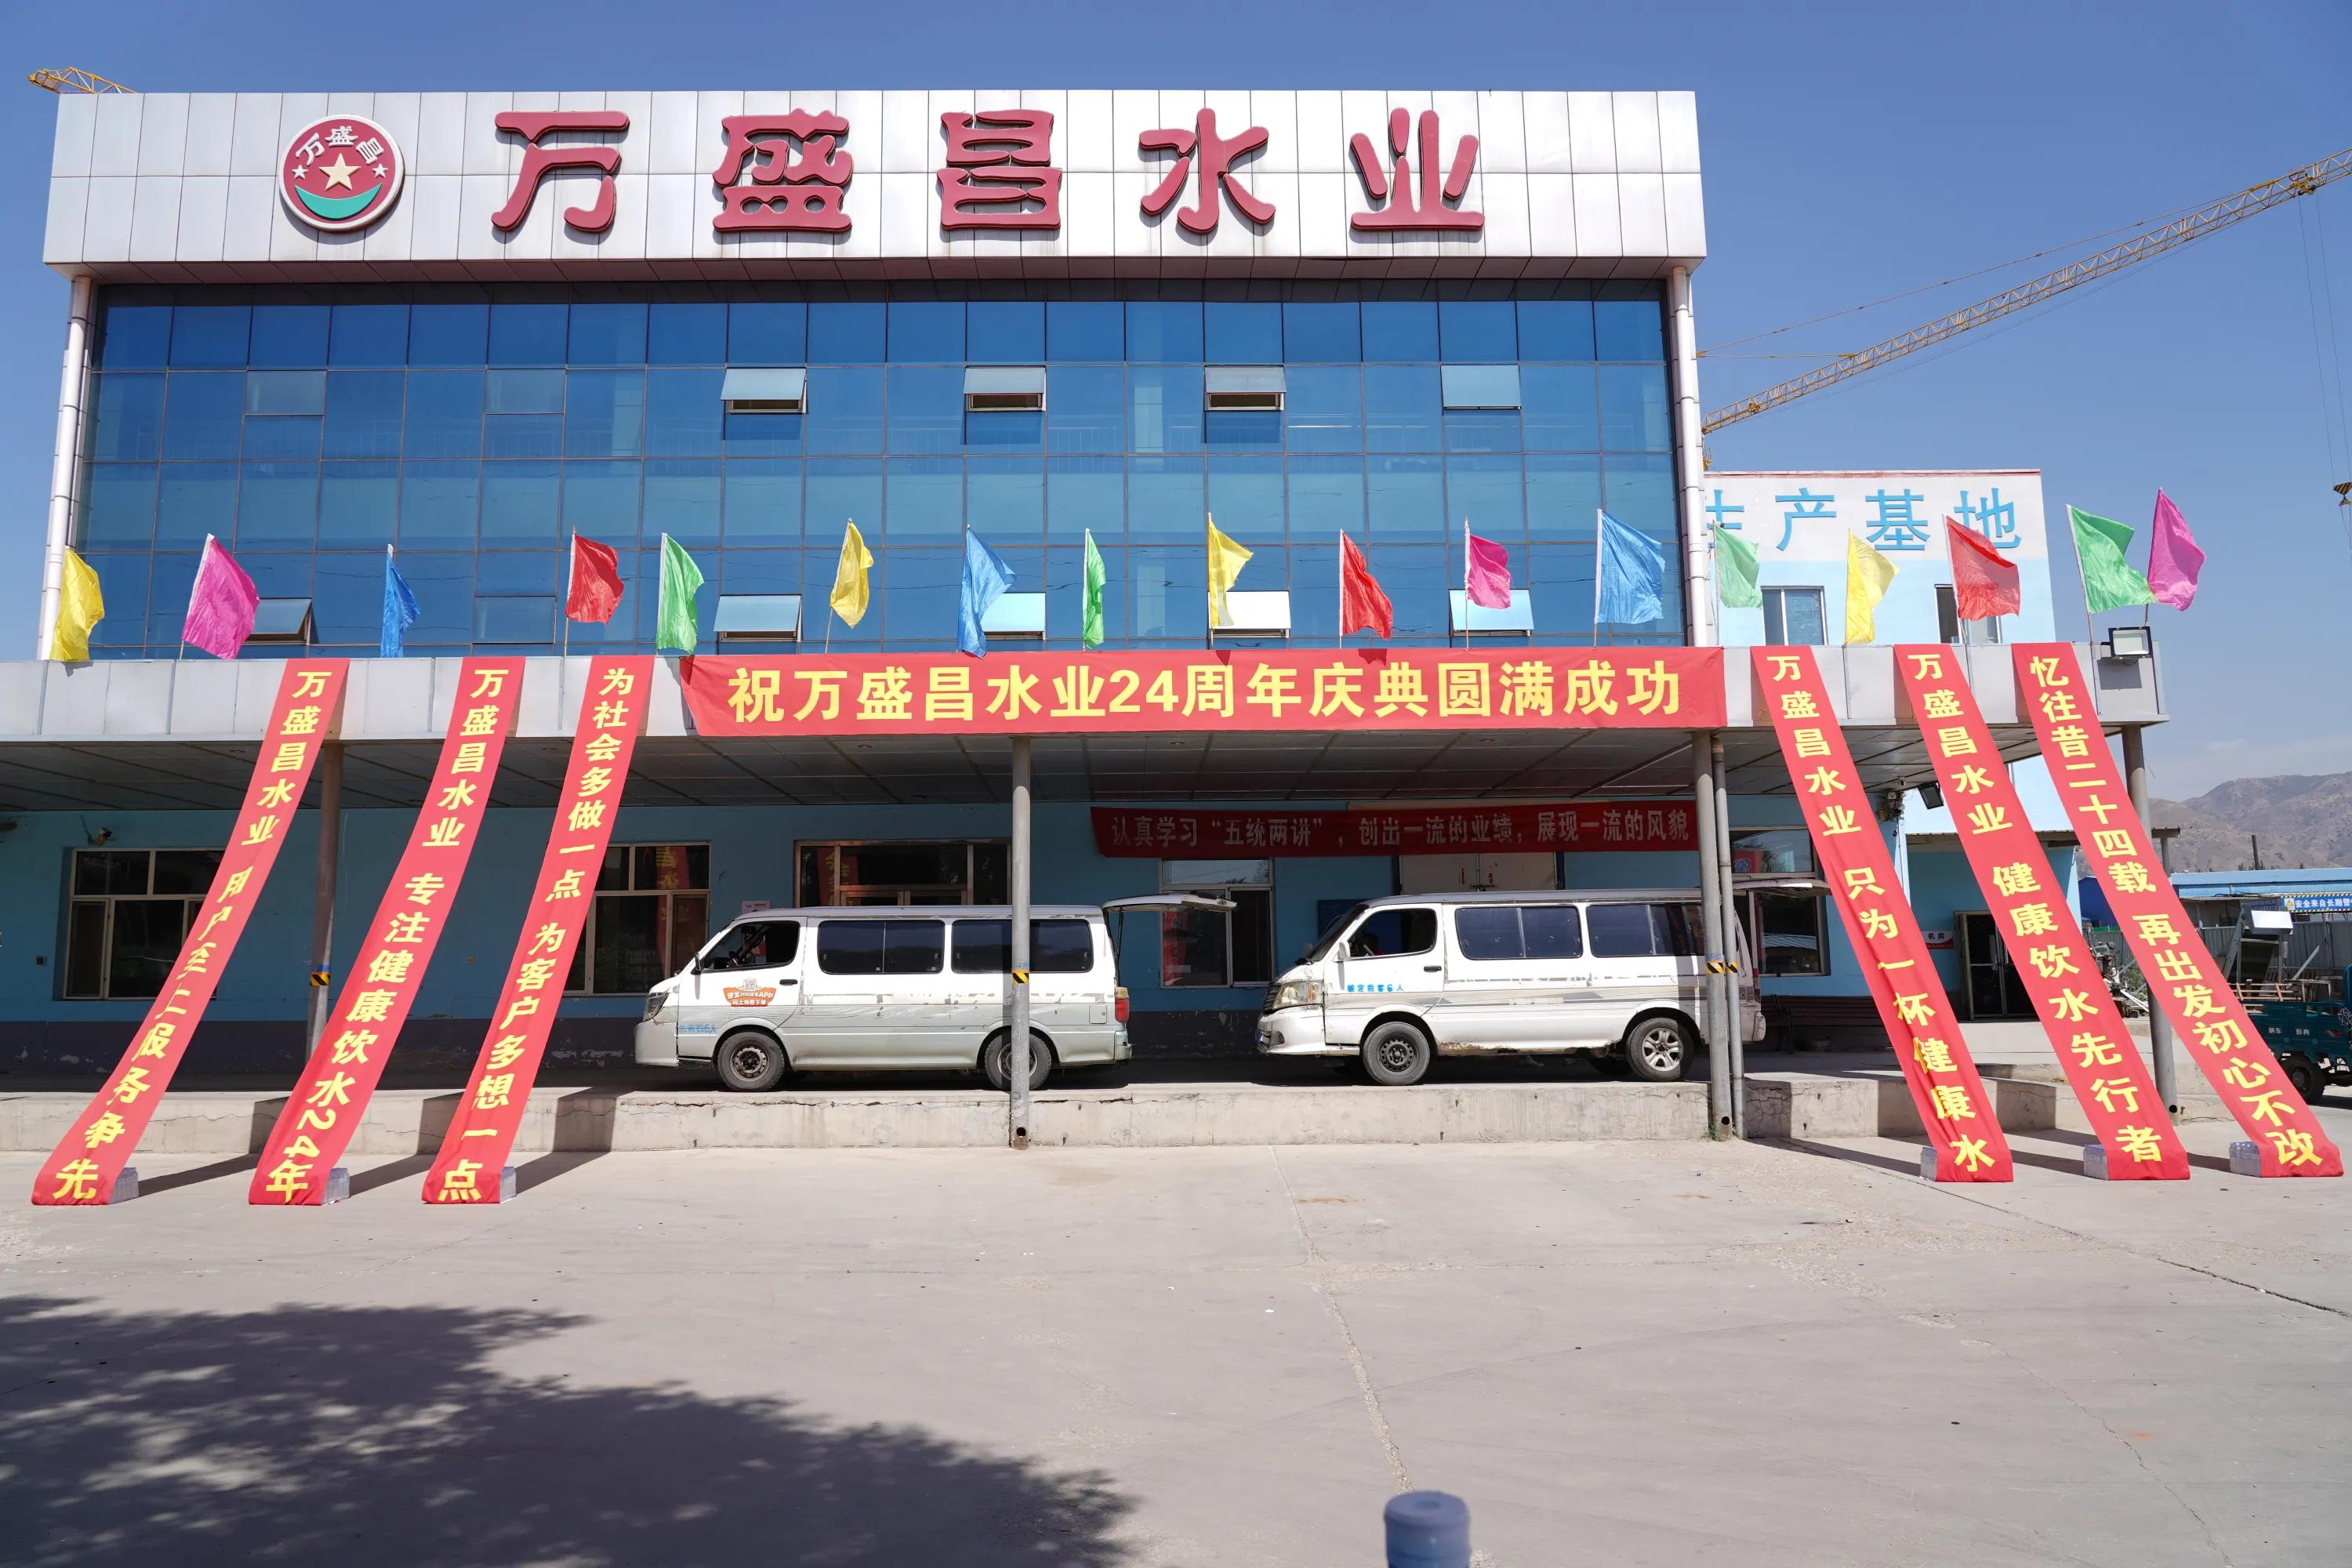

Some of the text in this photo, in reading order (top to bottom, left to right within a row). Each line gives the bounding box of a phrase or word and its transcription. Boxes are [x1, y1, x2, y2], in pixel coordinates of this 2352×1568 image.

[295, 125, 385, 167] 万盛昌
[491, 108, 1485, 235] 万盛昌水业
[728, 660, 1680, 723] 祝万盛昌水业24周年庆典圆满成功
[1768, 655, 1861, 837] 万盛昌水业
[266, 669, 508, 1203] 万盛昌水业 专注健康饮水24年
[437, 667, 634, 1202] 为社会多做一点 为客户多想一点
[1908, 653, 2162, 1163] 万盛昌水业 健康饮水先行者
[2030, 656, 2323, 1166] 忆往昔二十四载 再出发初心不改
[2295, 898, 2352, 909] 安全来自长期警
